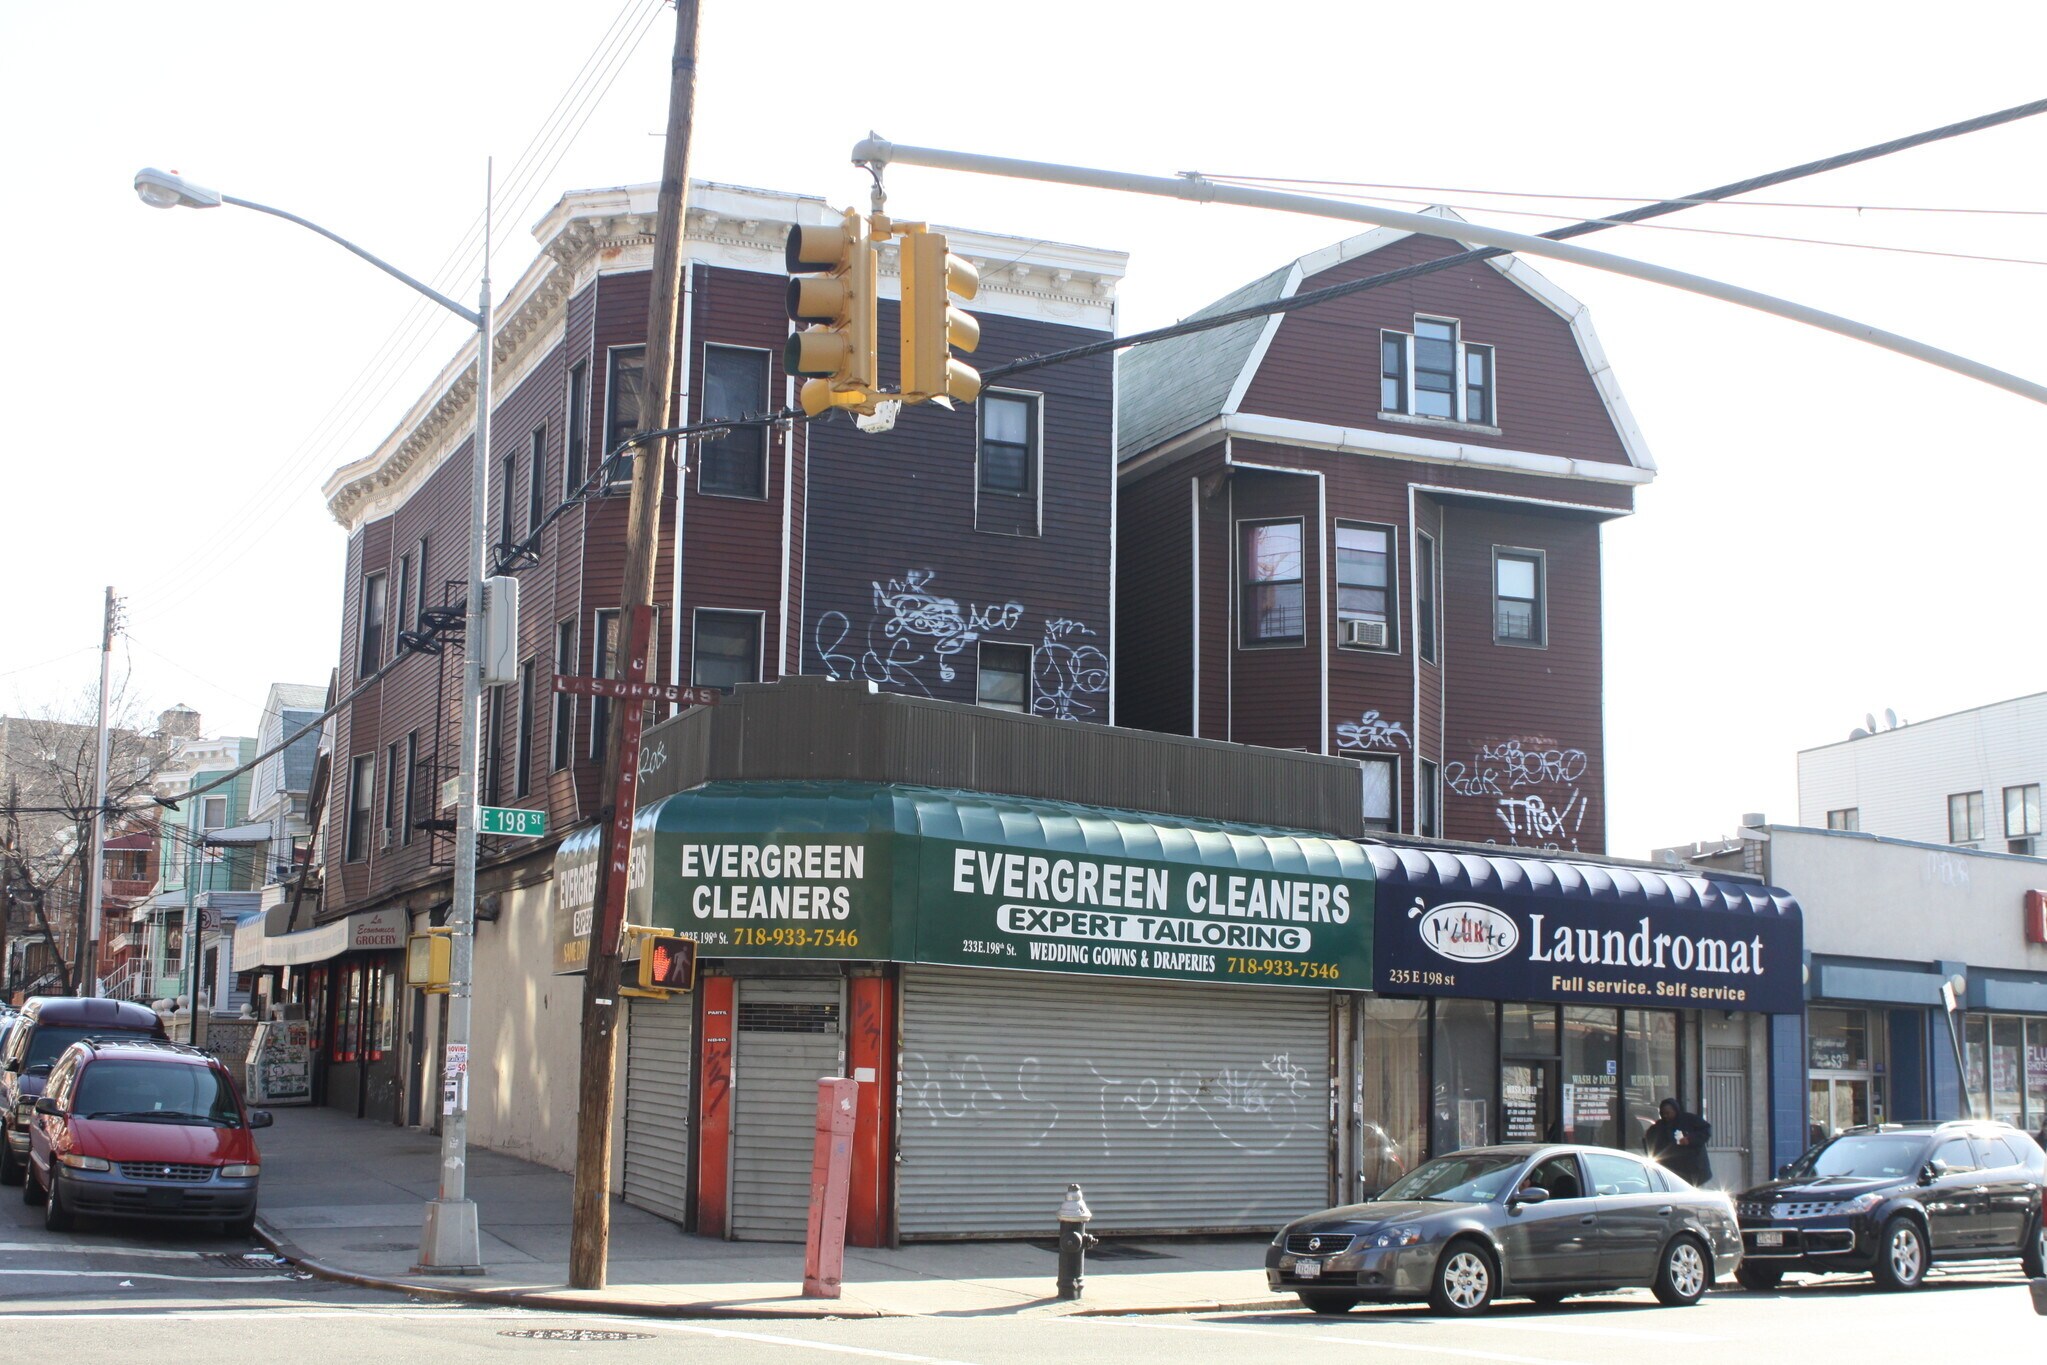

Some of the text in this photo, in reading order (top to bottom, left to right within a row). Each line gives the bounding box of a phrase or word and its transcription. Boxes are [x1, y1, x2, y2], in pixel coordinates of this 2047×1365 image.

[482, 810, 541, 833] E 198 St
[682, 844, 864, 879] EVERGREEN
[953, 848, 1350, 925] EVERGREEN CLEANERS
[692, 885, 850, 920] CLEANERS
[371, 914, 382, 925] La
[1008, 908, 1301, 950] EXPERT TAILORING
[355, 934, 397, 946] GROCERY
[718, 932, 729, 945] St.
[734, 927, 858, 947] 718-933-7546
[1529, 913, 1765, 976] Laundromat
[1006, 943, 1017, 956] St.
[1029, 941, 1341, 980] WEDDING GOWNS & DRAPERIES 718-933-7546
[1389, 969, 1455, 985] 235 E 198 st
[1552, 975, 1746, 1001] Full service. Self service
[2027, 1046, 2047, 1061] FLU
[1572, 1075, 1617, 1085] WASH & FOLD
